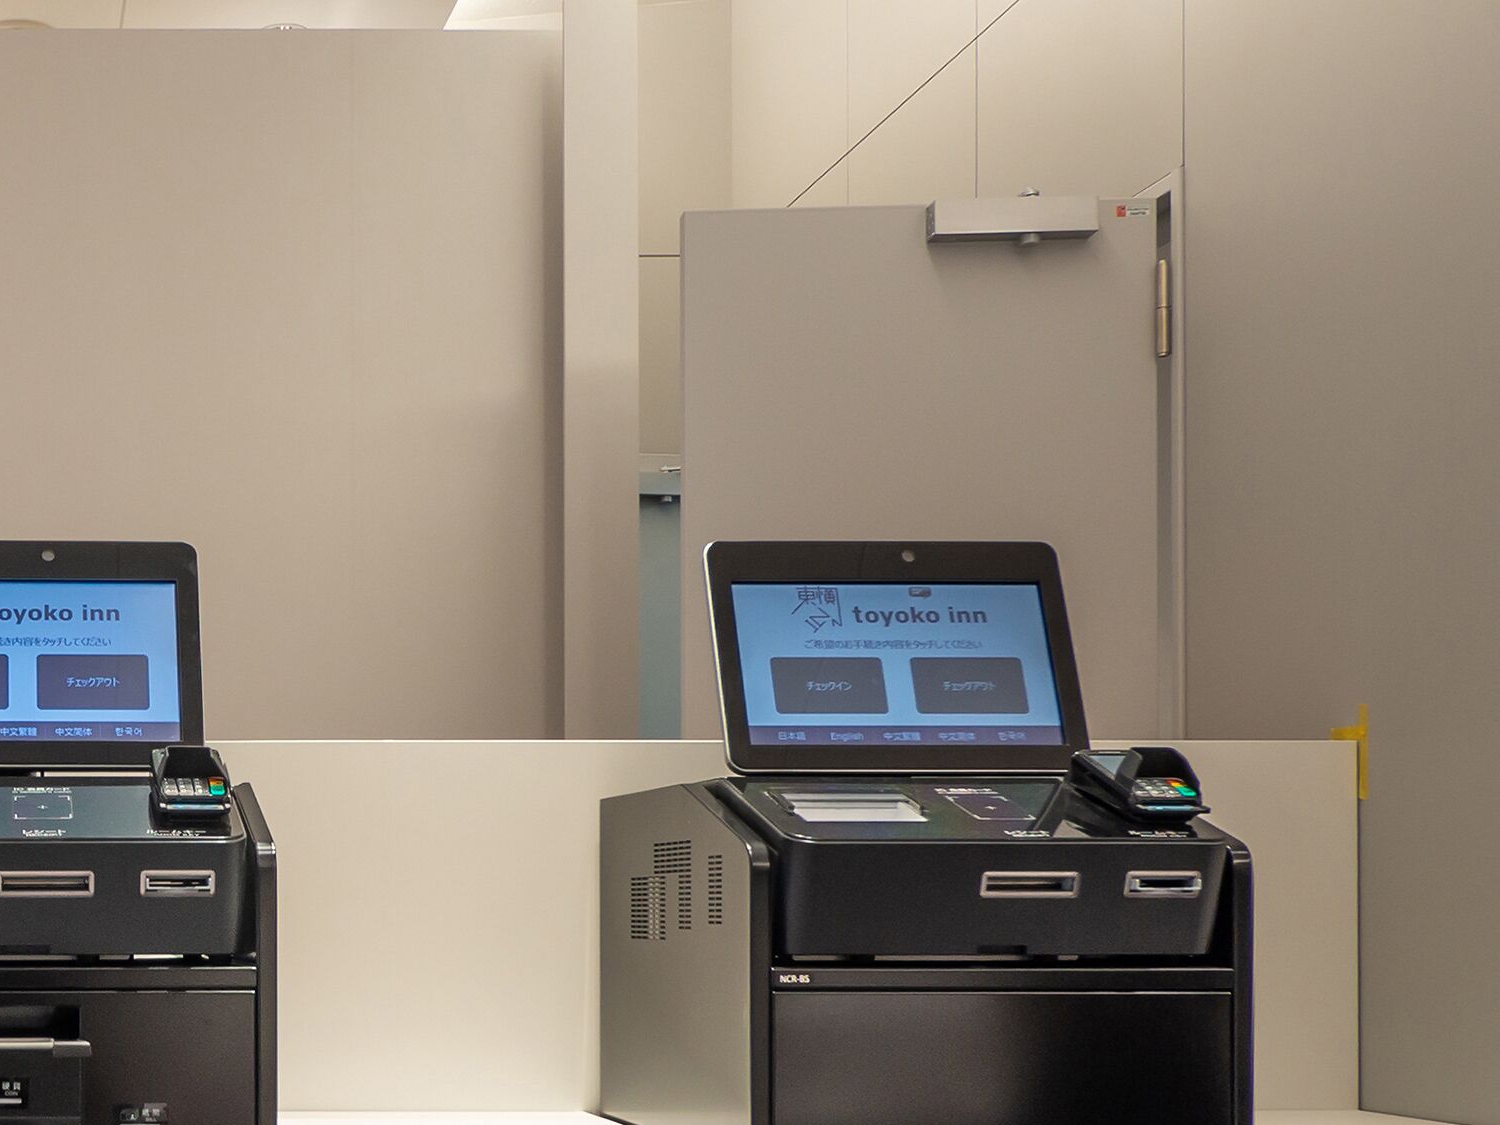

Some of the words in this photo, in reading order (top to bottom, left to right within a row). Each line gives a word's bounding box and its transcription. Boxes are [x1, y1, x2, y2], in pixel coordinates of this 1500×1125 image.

[82, 604, 120, 621] inn
[853, 606, 940, 627] toyoko
[948, 606, 987, 623] inn
[67, 677, 120, 687] チェックアウト
[115, 727, 142, 737] 한국어
[830, 732, 864, 742] English
